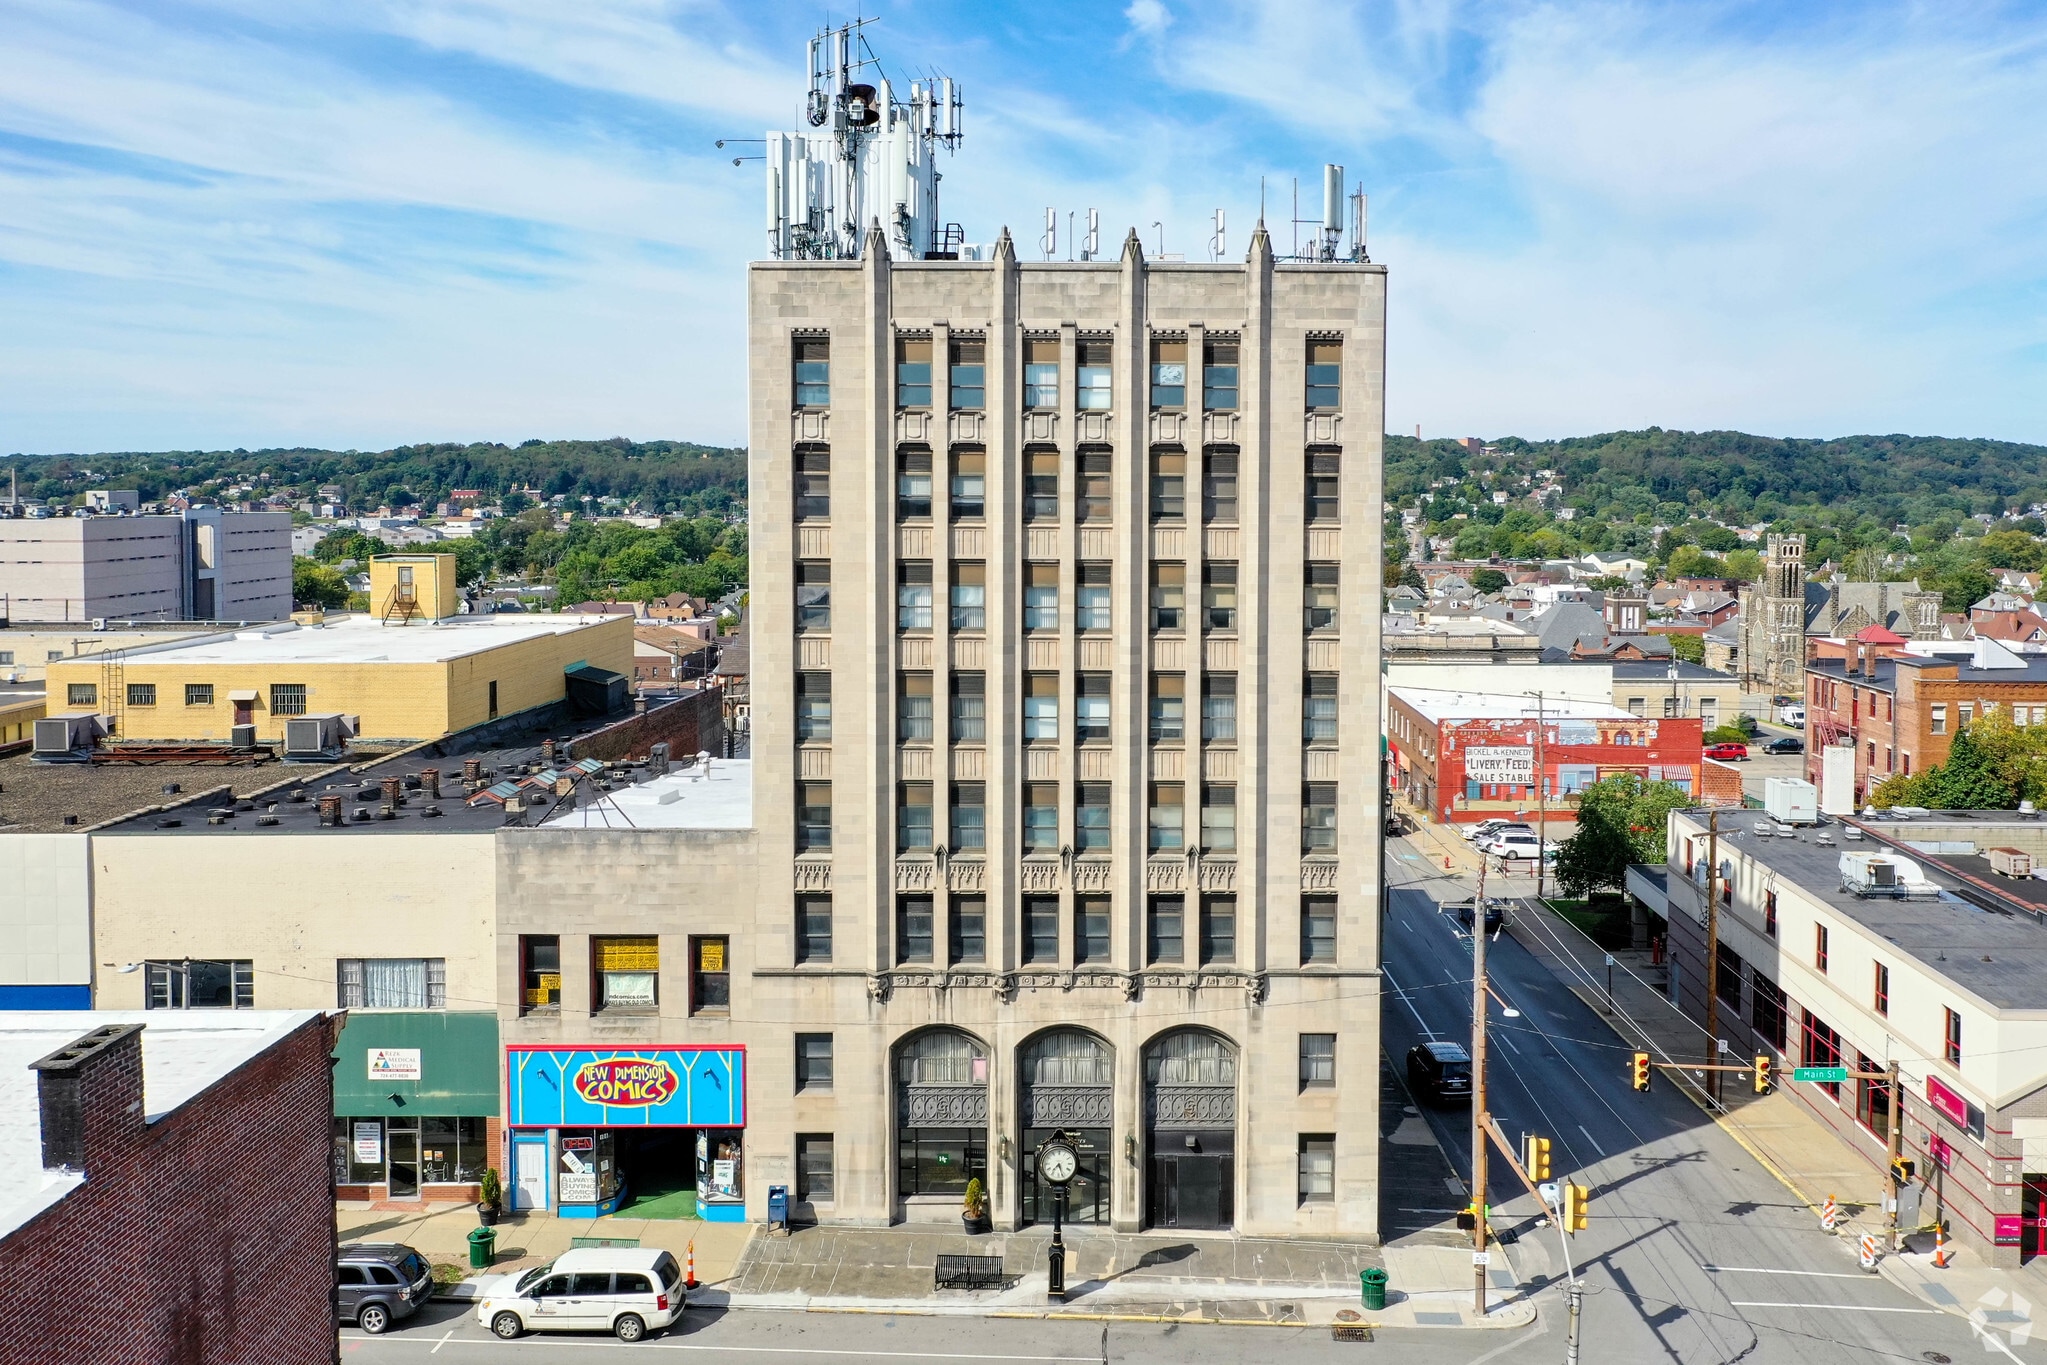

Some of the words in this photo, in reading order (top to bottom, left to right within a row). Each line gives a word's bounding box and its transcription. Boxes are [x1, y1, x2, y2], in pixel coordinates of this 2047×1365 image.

[1466, 748, 1491, 756] BICKEL
[1500, 748, 1532, 756] KENNEDY
[1474, 772, 1495, 782] SALE
[1498, 773, 1533, 782] STABLE
[584, 1066, 609, 1082] NEW
[615, 1065, 665, 1081] DIMENSION
[1803, 1070, 1824, 1079] Main
[1827, 1070, 1836, 1079] St
[583, 1077, 668, 1102] COMICS
[564, 1139, 592, 1149] OPEN
[561, 1176, 597, 1184] ALWAYS
